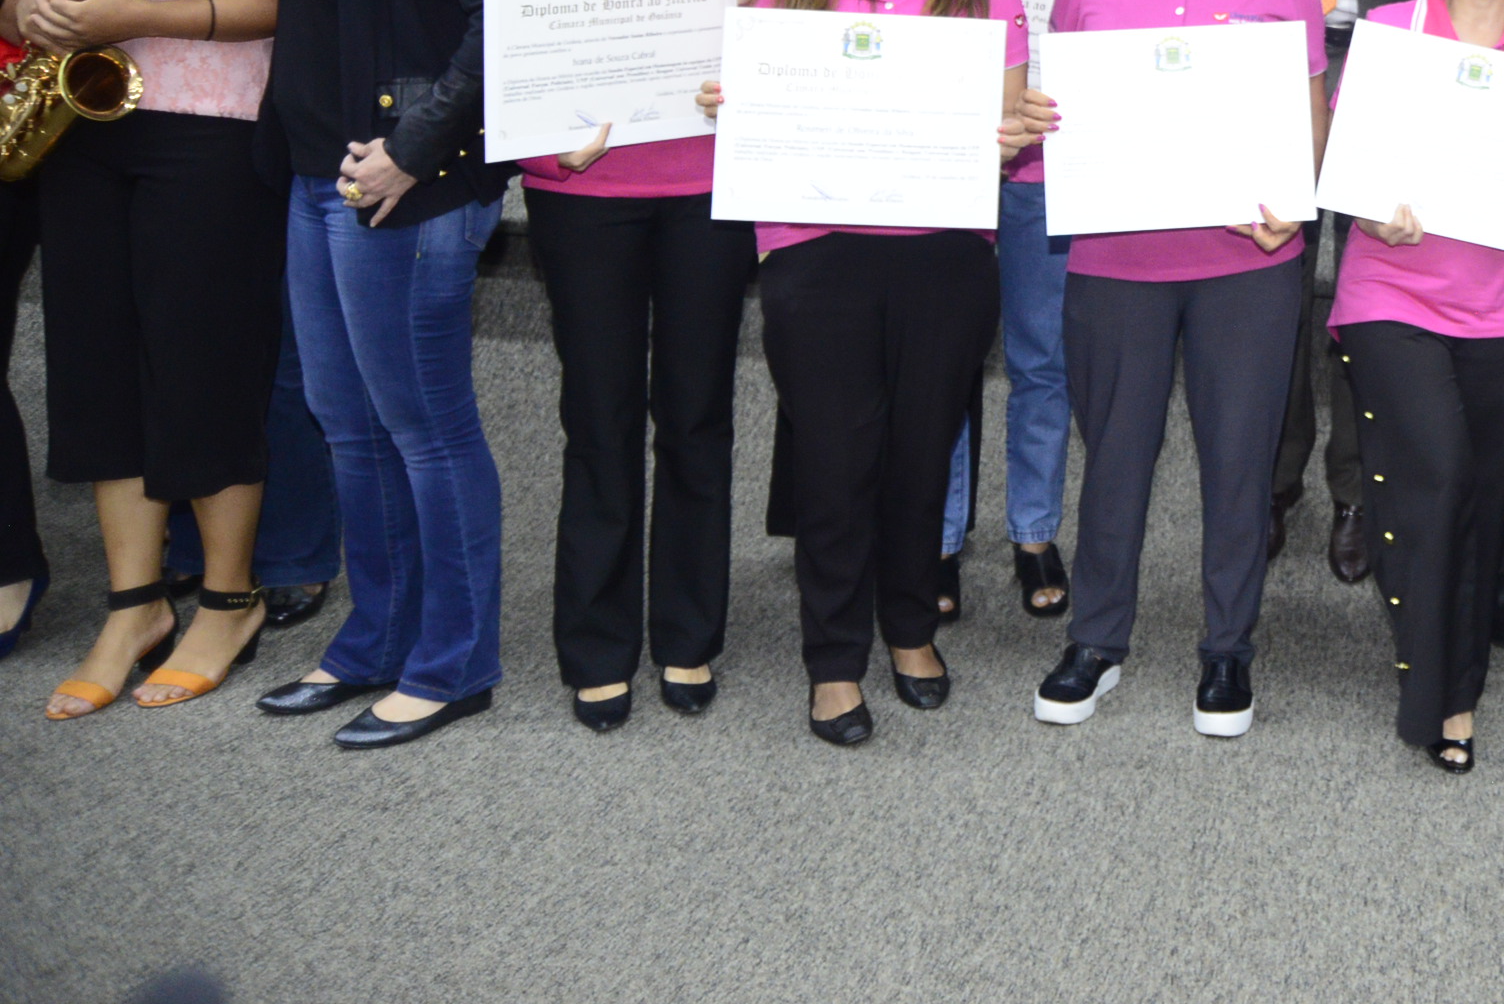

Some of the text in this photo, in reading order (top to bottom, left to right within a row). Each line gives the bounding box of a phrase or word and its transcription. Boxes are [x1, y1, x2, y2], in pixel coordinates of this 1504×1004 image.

[520, 0, 578, 18] Diploma
[583, 0, 597, 13] de
[757, 62, 818, 79] Diploma
